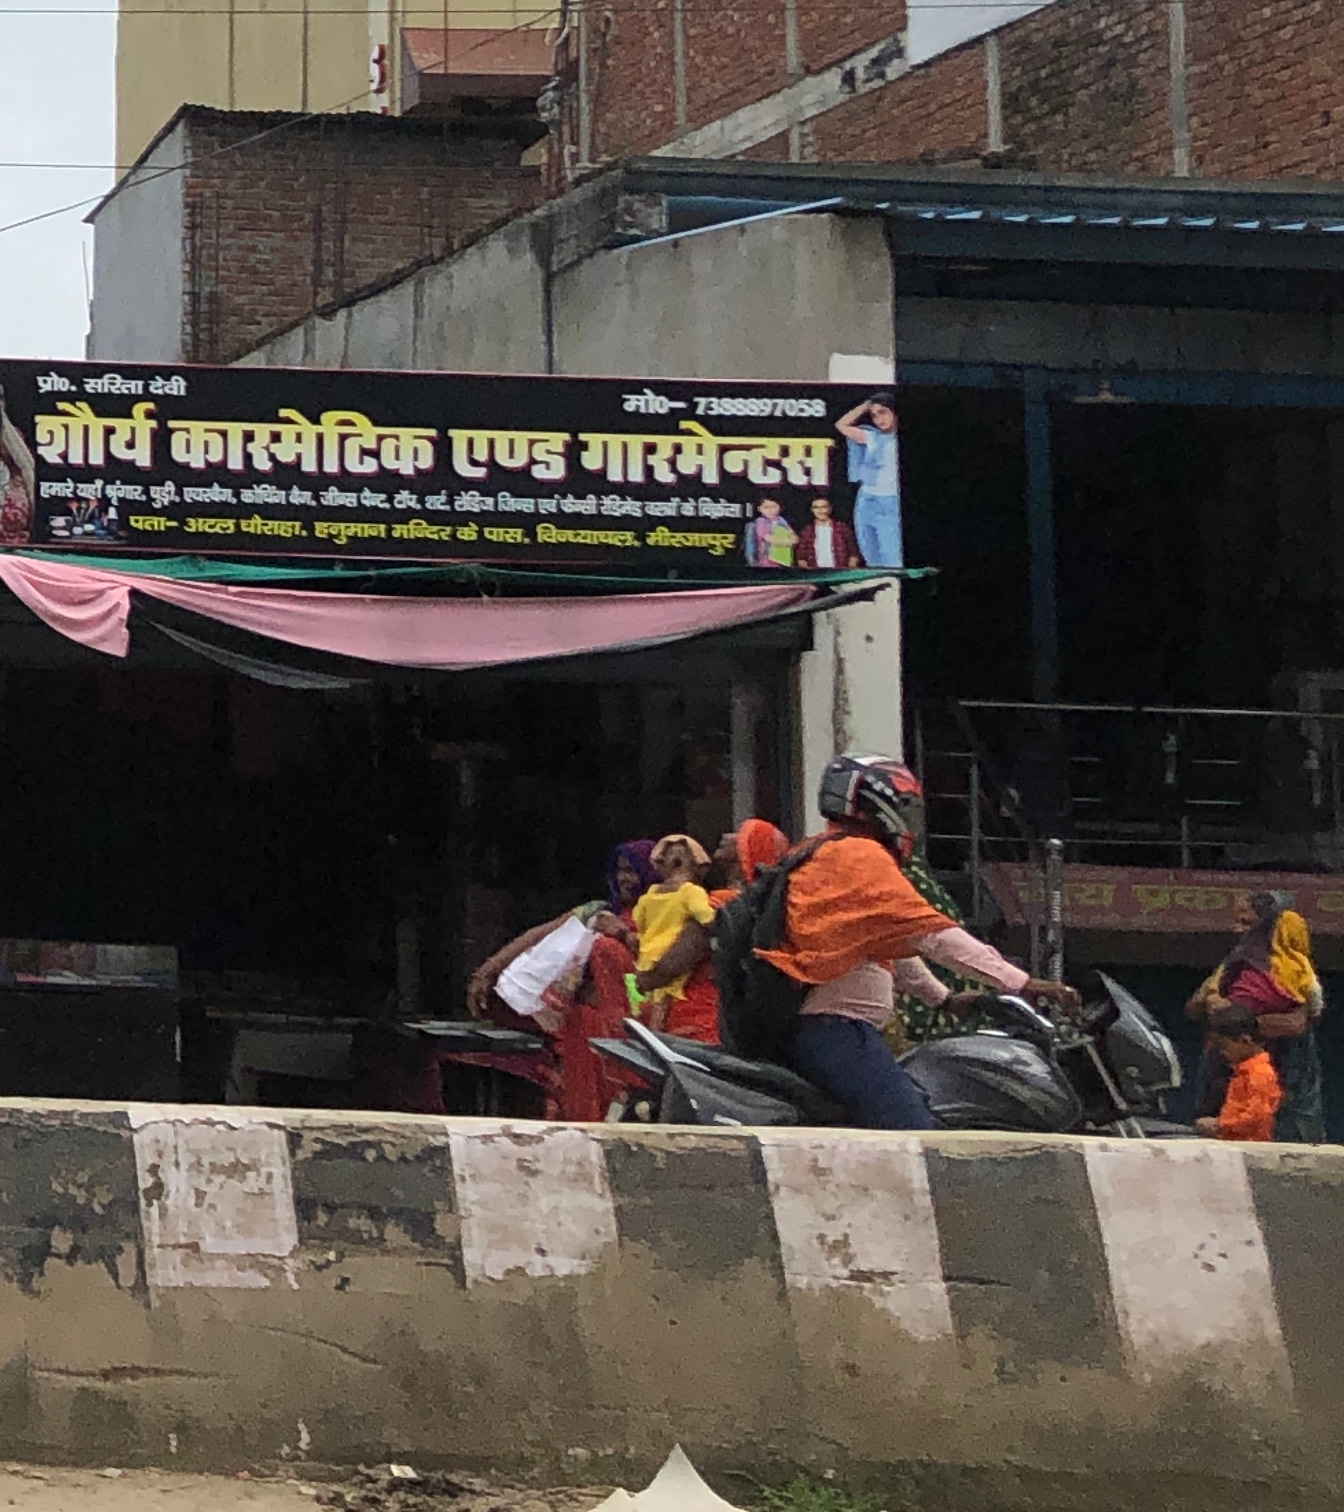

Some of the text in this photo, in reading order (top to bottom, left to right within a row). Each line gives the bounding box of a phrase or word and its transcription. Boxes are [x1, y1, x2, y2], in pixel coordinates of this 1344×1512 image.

[82, 373, 144, 395] सरिता
[148, 375, 187, 396] देवी
[34, 401, 158, 468] शौर्य
[447, 427, 571, 481] एण्ड
[39, 477, 75, 499] हमारे
[183, 516, 236, 534] अटल
[314, 520, 387, 545] हनुमान
[456, 521, 479, 541] के
